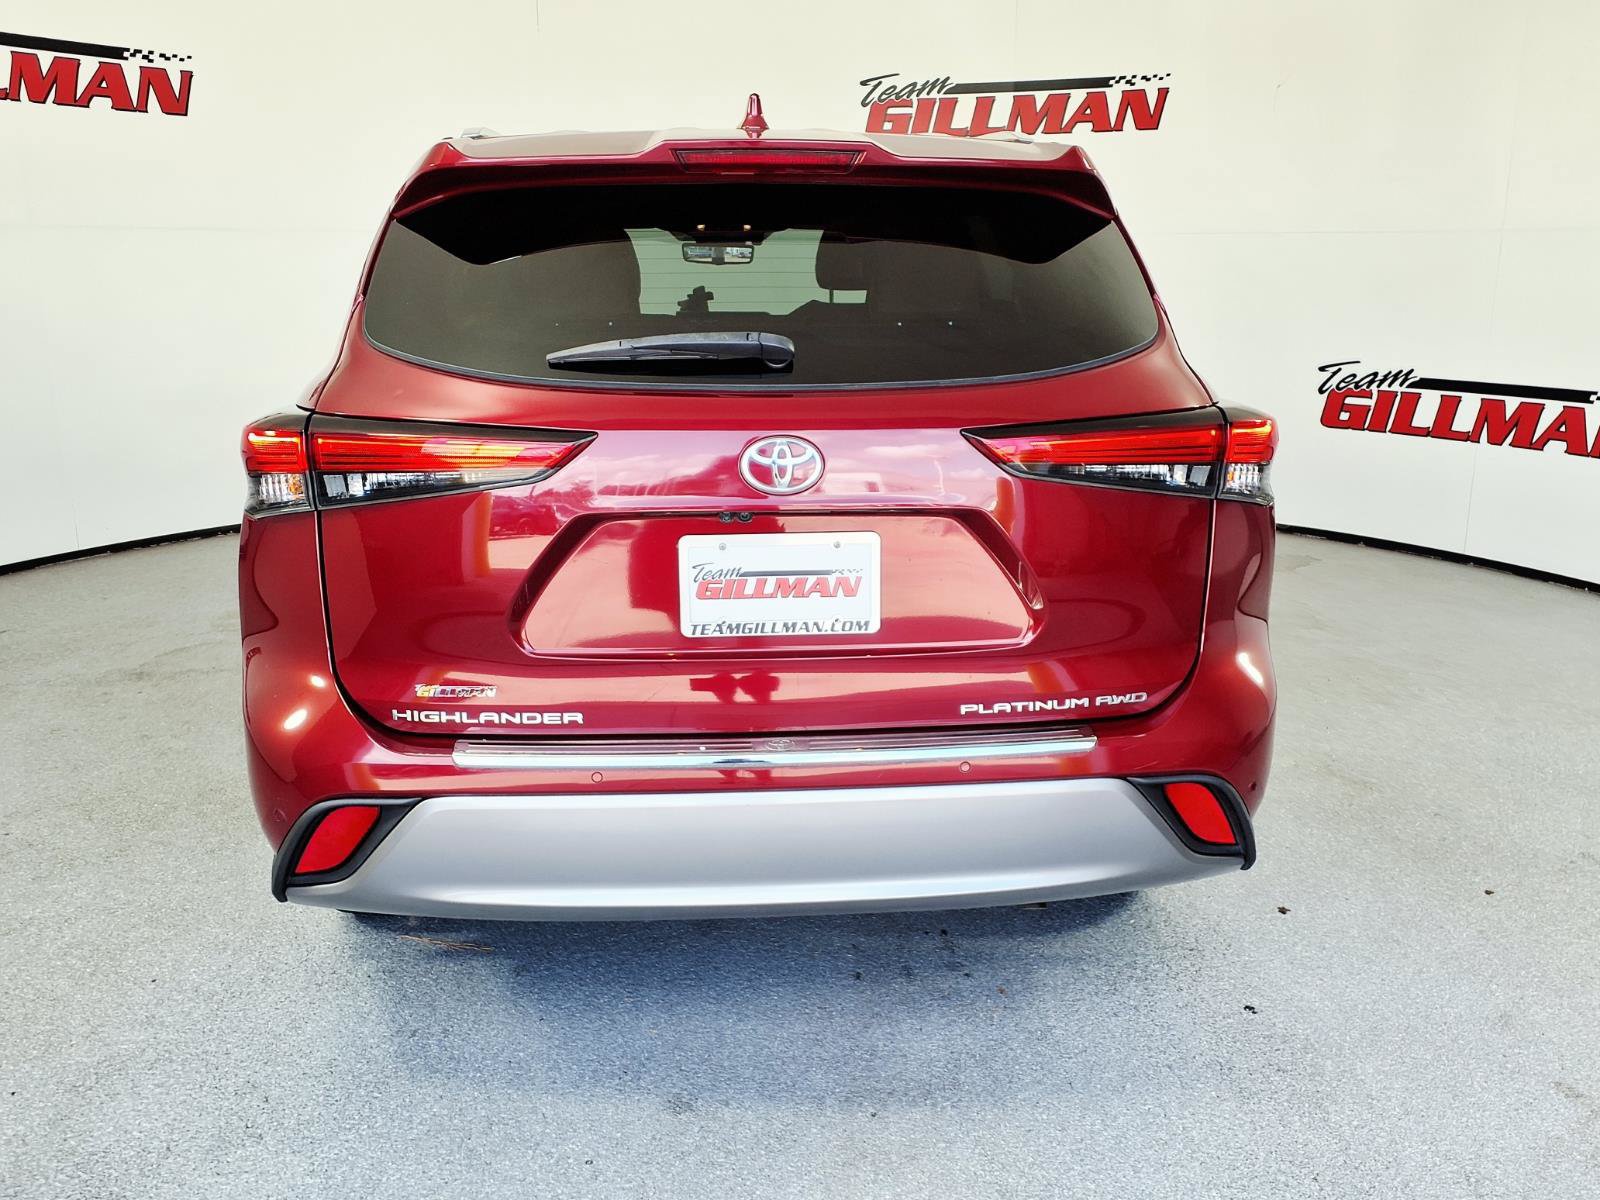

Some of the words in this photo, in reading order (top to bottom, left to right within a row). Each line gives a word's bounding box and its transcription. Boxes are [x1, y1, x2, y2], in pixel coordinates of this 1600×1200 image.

[0, 51, 193, 116] MAN
[859, 73, 956, 108] Team
[865, 87, 1169, 137] GILLMAN
[1317, 360, 1417, 395] Team
[1320, 388, 1600, 459] GILLMA
[692, 562, 743, 583] Team
[695, 575, 863, 600] GILLMAN
[690, 619, 870, 636] TEAMGILLMAN.COM
[391, 709, 584, 725] HIGHLANDER
[959, 696, 1089, 715] PLATINUM
[1095, 691, 1148, 707] AWD
